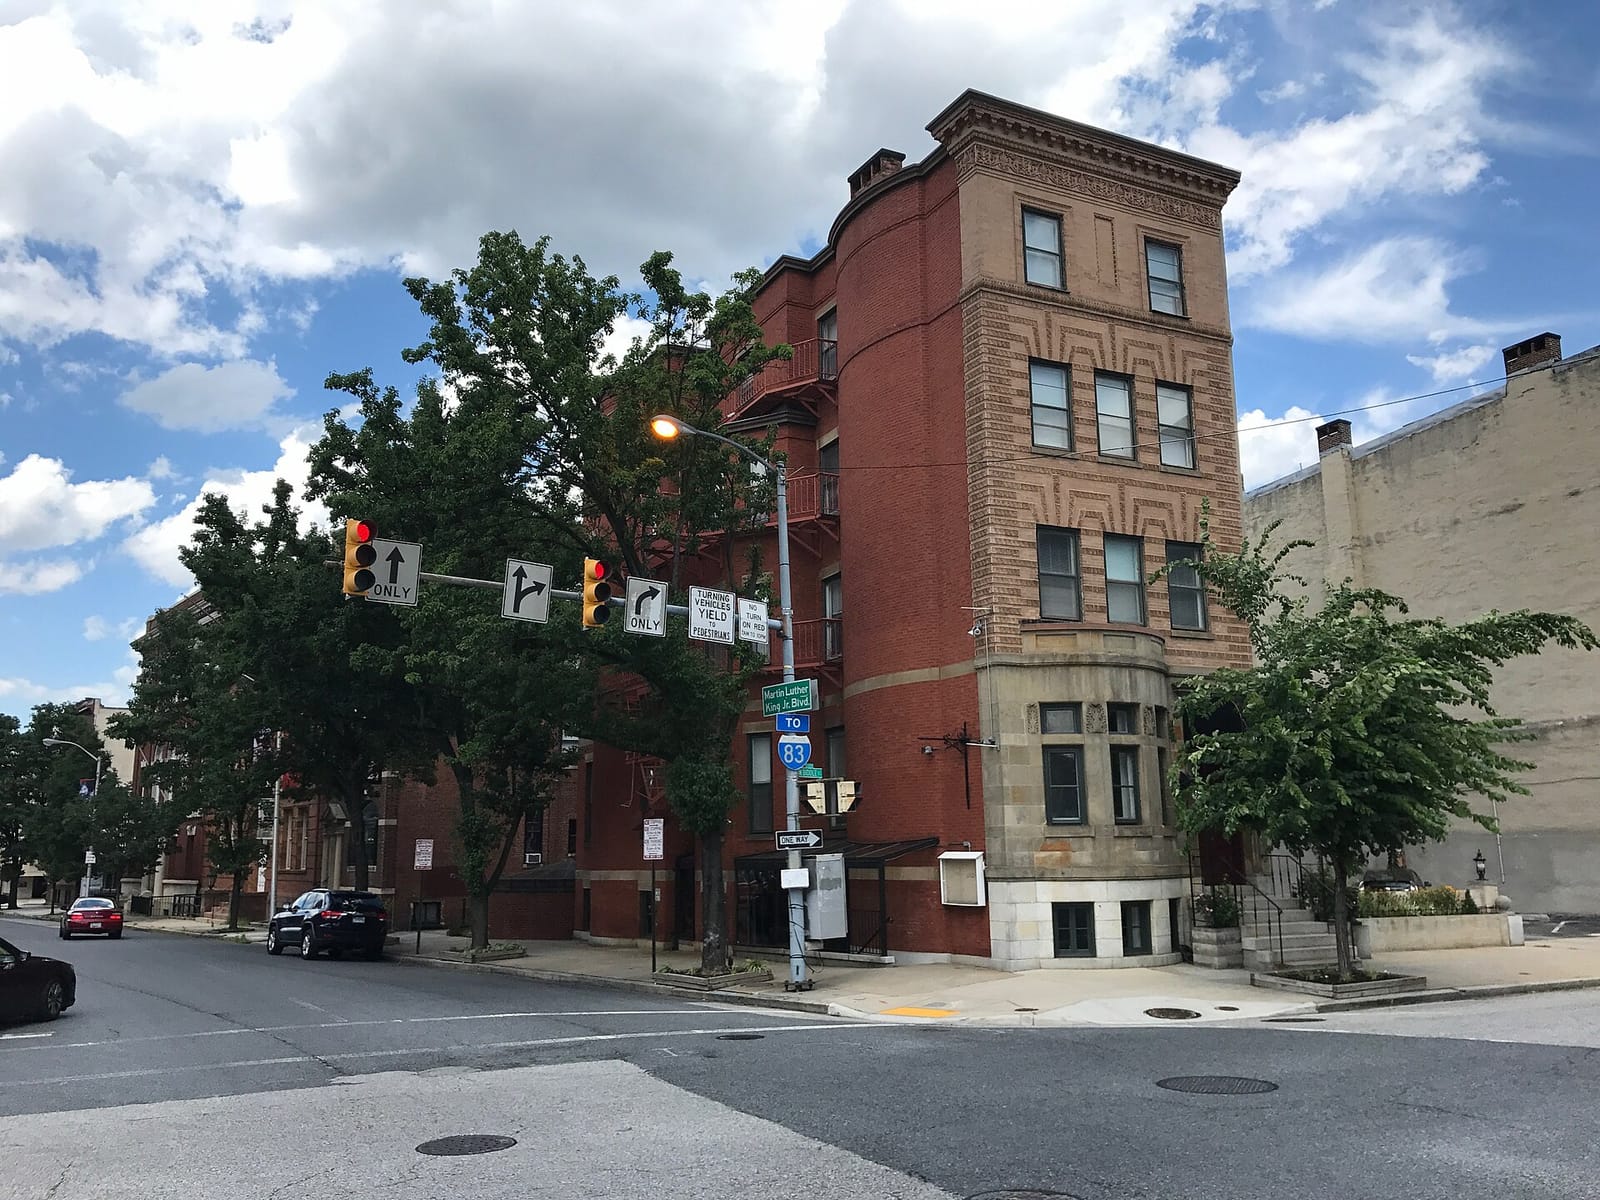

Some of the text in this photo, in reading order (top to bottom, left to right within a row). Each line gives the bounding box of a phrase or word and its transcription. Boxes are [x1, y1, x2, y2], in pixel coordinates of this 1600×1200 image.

[374, 583, 411, 599] ONLY
[698, 590, 730, 603] TURNING
[695, 598, 731, 611] VEHICLES
[698, 607, 727, 621] YIELD
[746, 612, 762, 621] TURN
[631, 617, 661, 631] ONLY
[742, 621, 766, 632] ON RED
[693, 626, 730, 640] PEDESTRIANS
[765, 686, 808, 700] Martin Luther
[765, 697, 810, 713] King Jr. Blvd.
[785, 718, 801, 728] TO
[784, 744, 804, 763] 83
